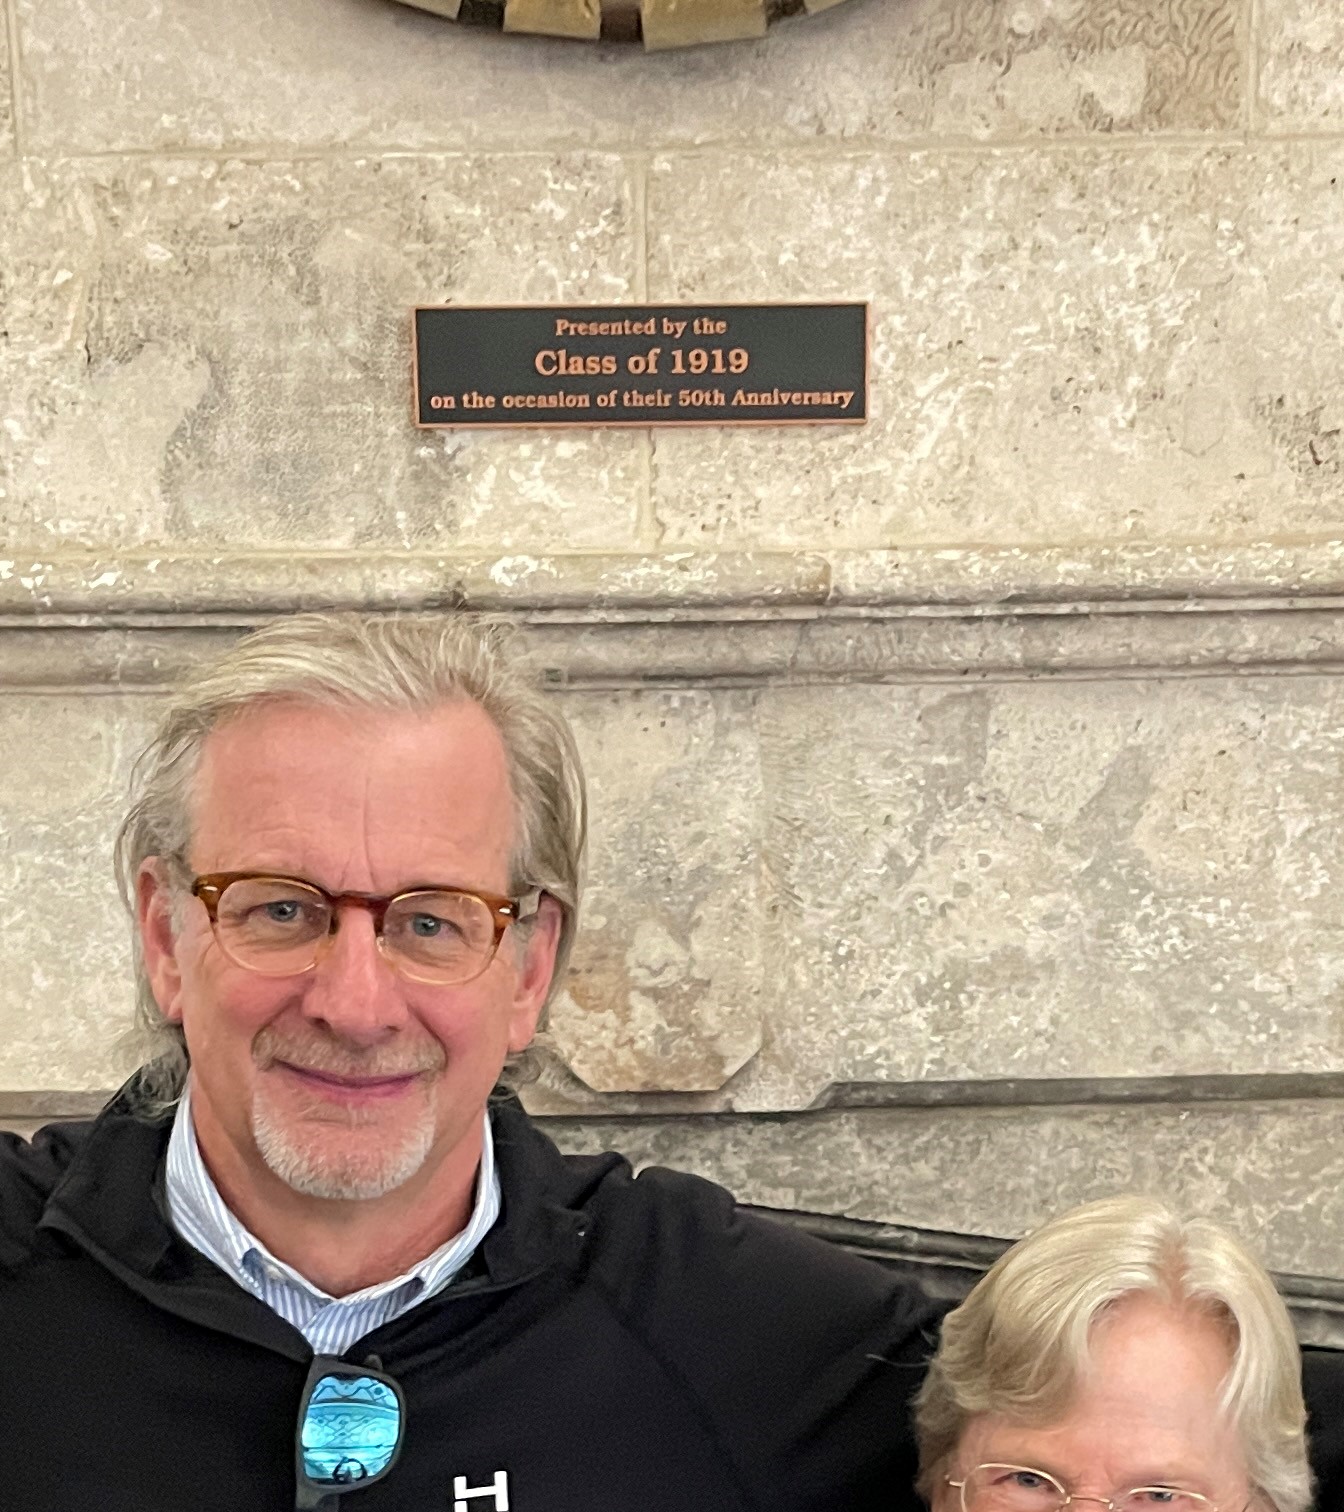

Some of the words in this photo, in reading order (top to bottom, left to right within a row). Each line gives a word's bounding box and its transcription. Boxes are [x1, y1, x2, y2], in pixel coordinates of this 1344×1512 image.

[555, 318, 657, 337] Presented
[662, 318, 688, 340] by
[692, 318, 728, 336] the
[535, 349, 618, 376] Class
[627, 347, 662, 376] of
[671, 348, 750, 375] 1919
[430, 394, 456, 410] on
[462, 390, 496, 410] the
[502, 390, 590, 409] occasion
[596, 388, 618, 408] of
[622, 388, 673, 408] their
[678, 388, 726, 408] 50th
[731, 388, 855, 410] Anniversary
